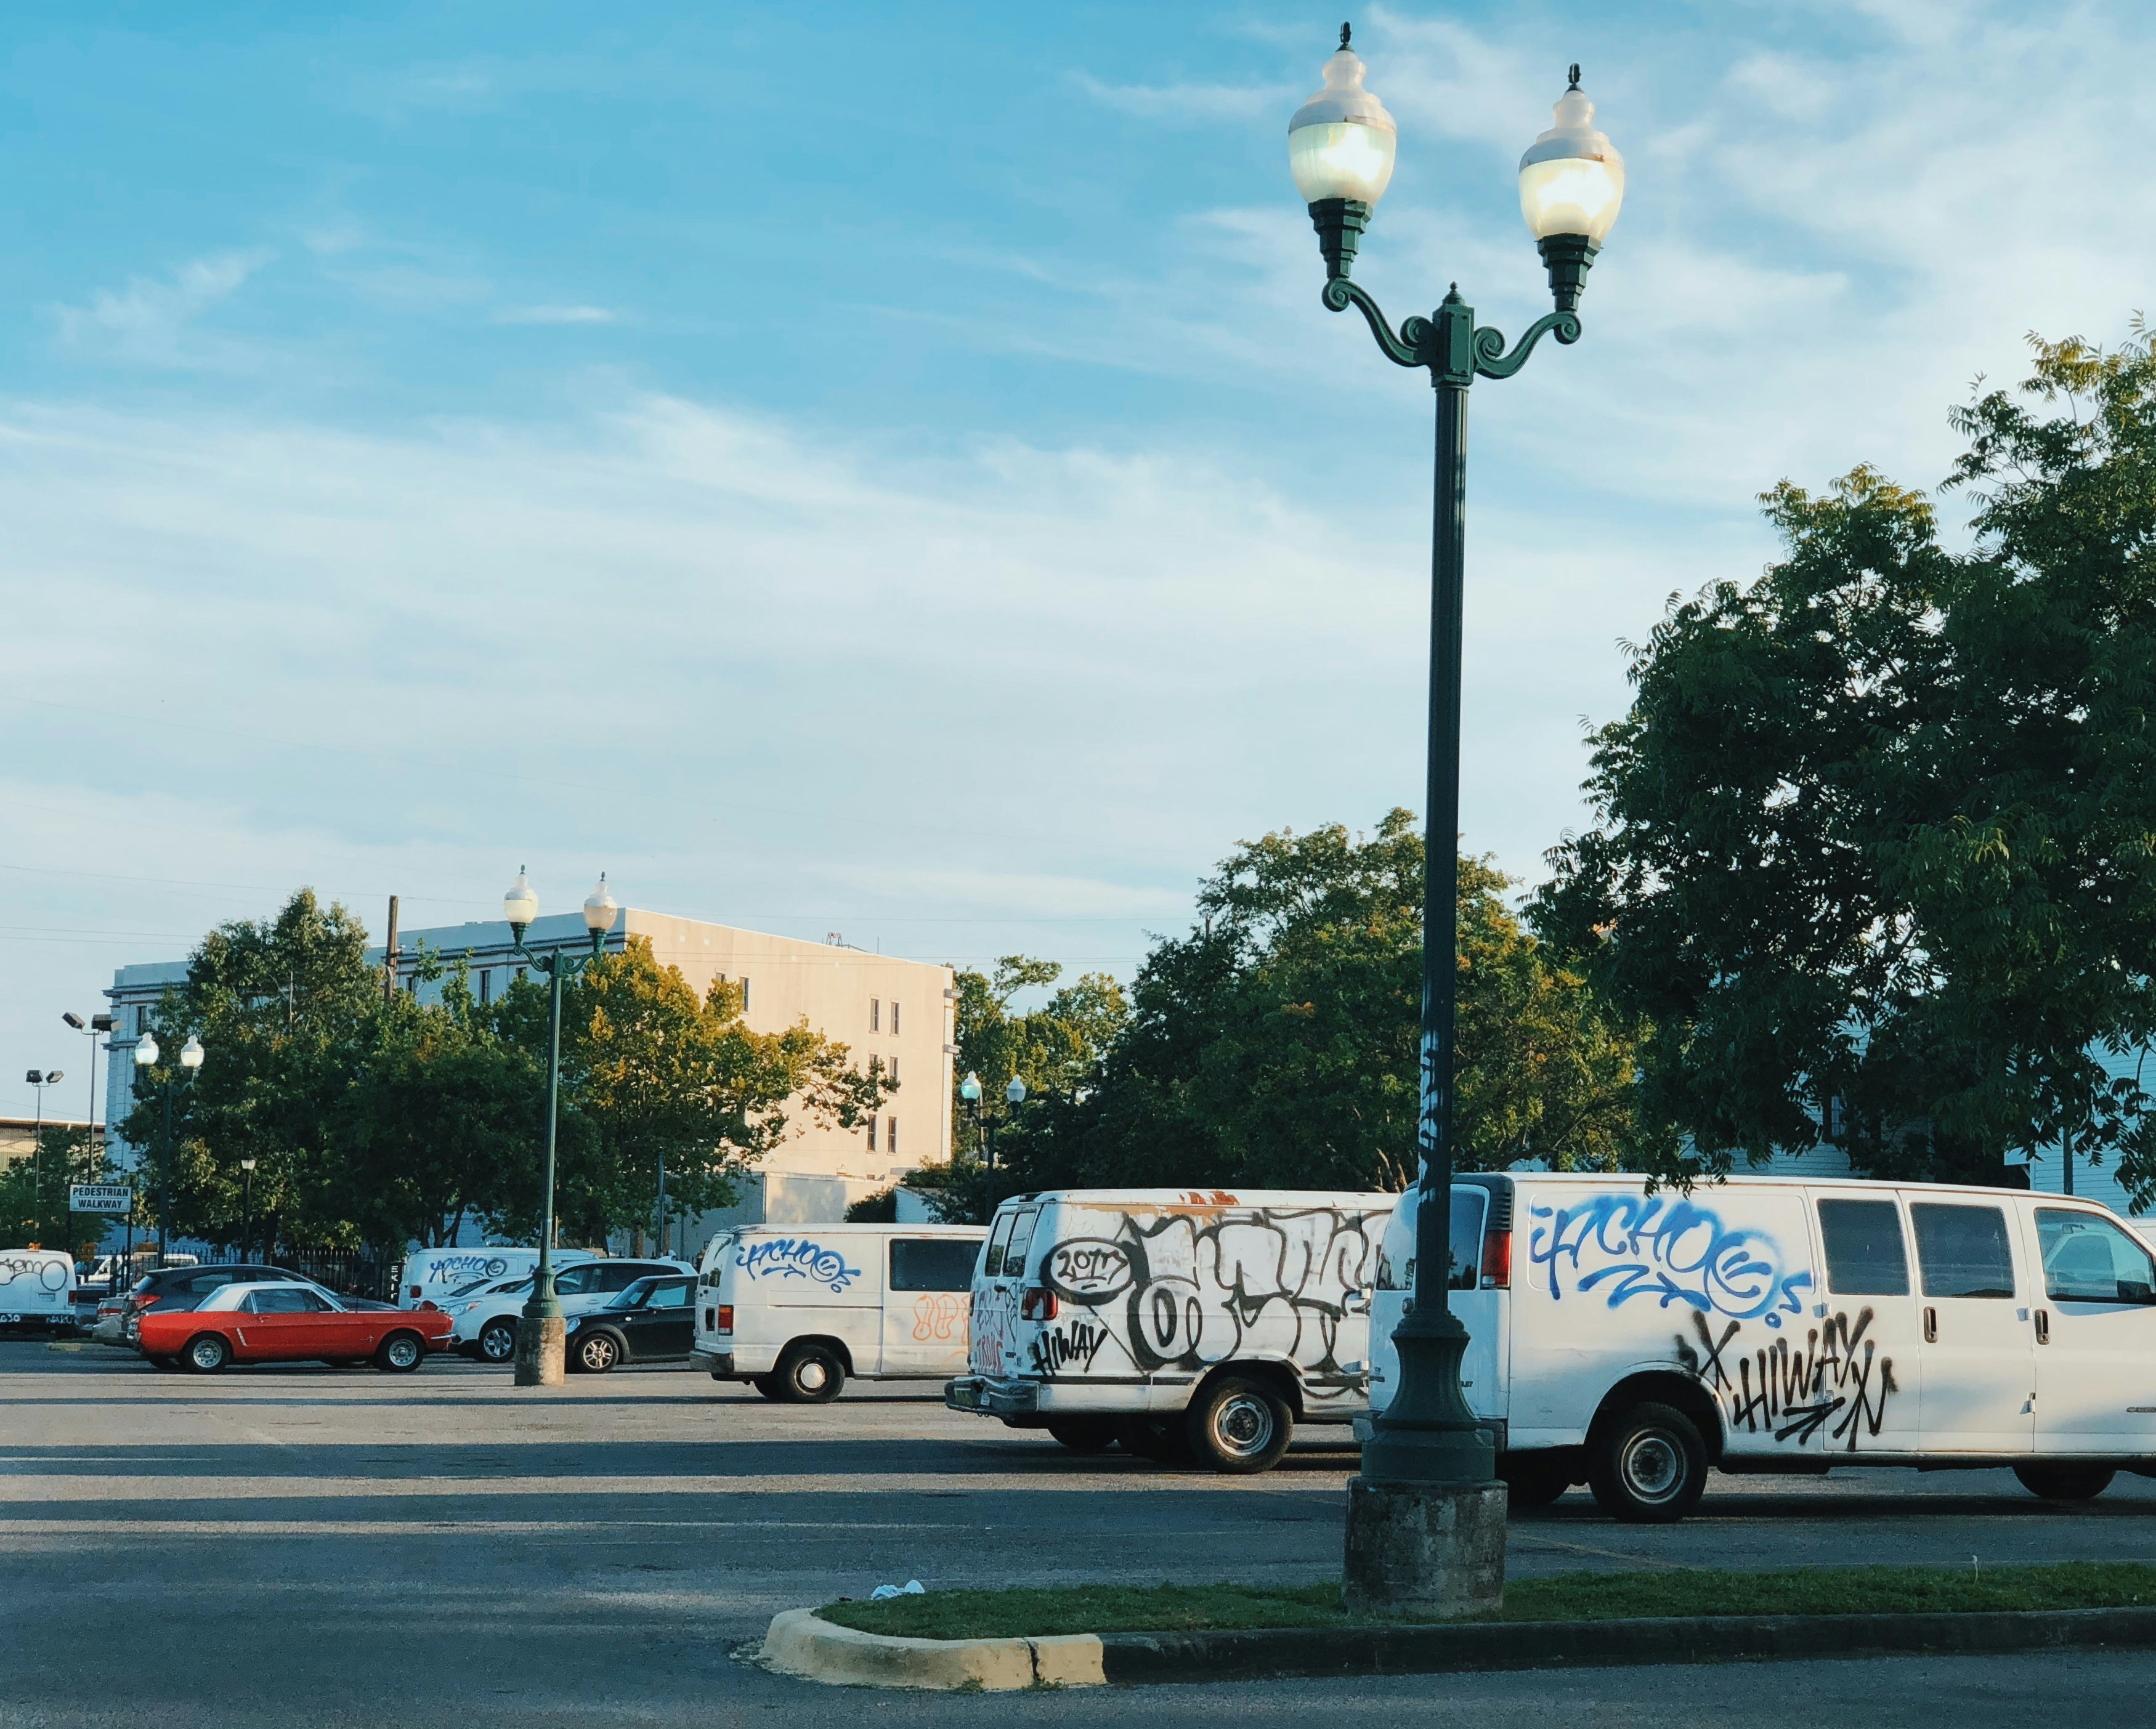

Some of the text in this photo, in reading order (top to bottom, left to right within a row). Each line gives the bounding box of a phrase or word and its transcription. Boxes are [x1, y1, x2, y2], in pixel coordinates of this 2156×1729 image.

[73, 1187, 128, 1197] PEDESTRIAN
[78, 1199, 123, 1209] WALKWAY
[1030, 1320, 1108, 1377] HIWAY
